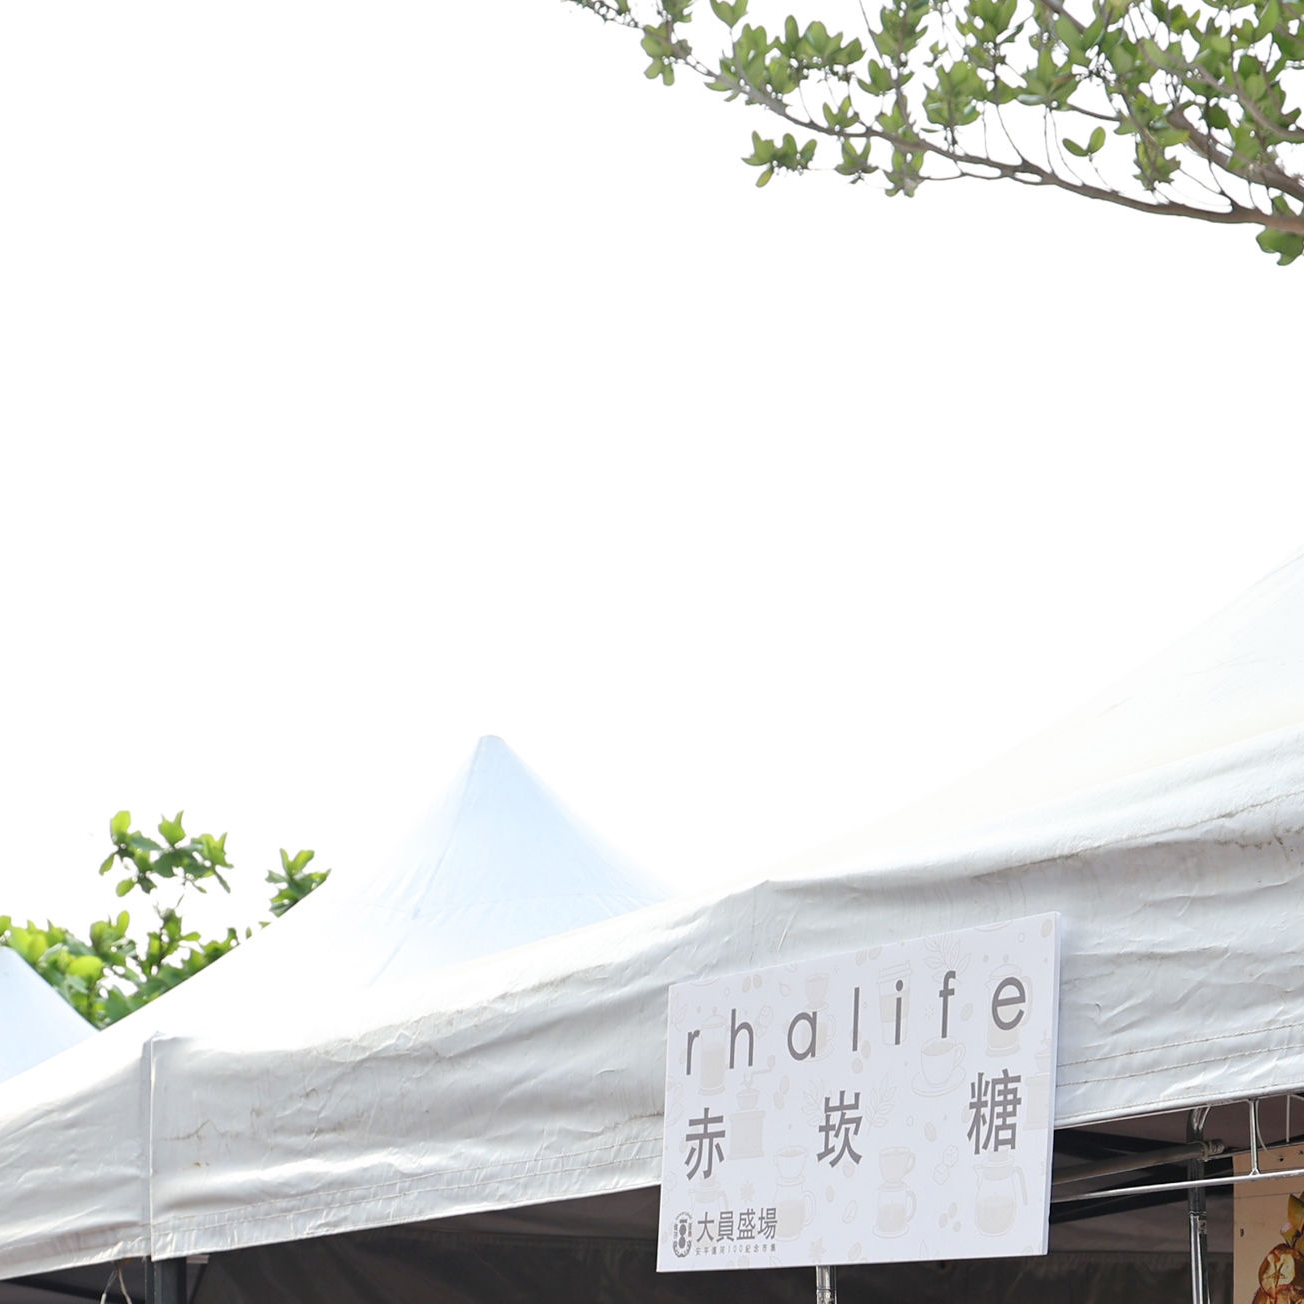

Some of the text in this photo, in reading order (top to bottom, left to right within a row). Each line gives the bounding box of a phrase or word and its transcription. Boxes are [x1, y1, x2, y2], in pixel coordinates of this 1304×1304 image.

[685, 970, 1026, 1076] rhalife
[683, 1069, 1022, 1181] 赤崁糖
[696, 1207, 778, 1243] 大員盛場
